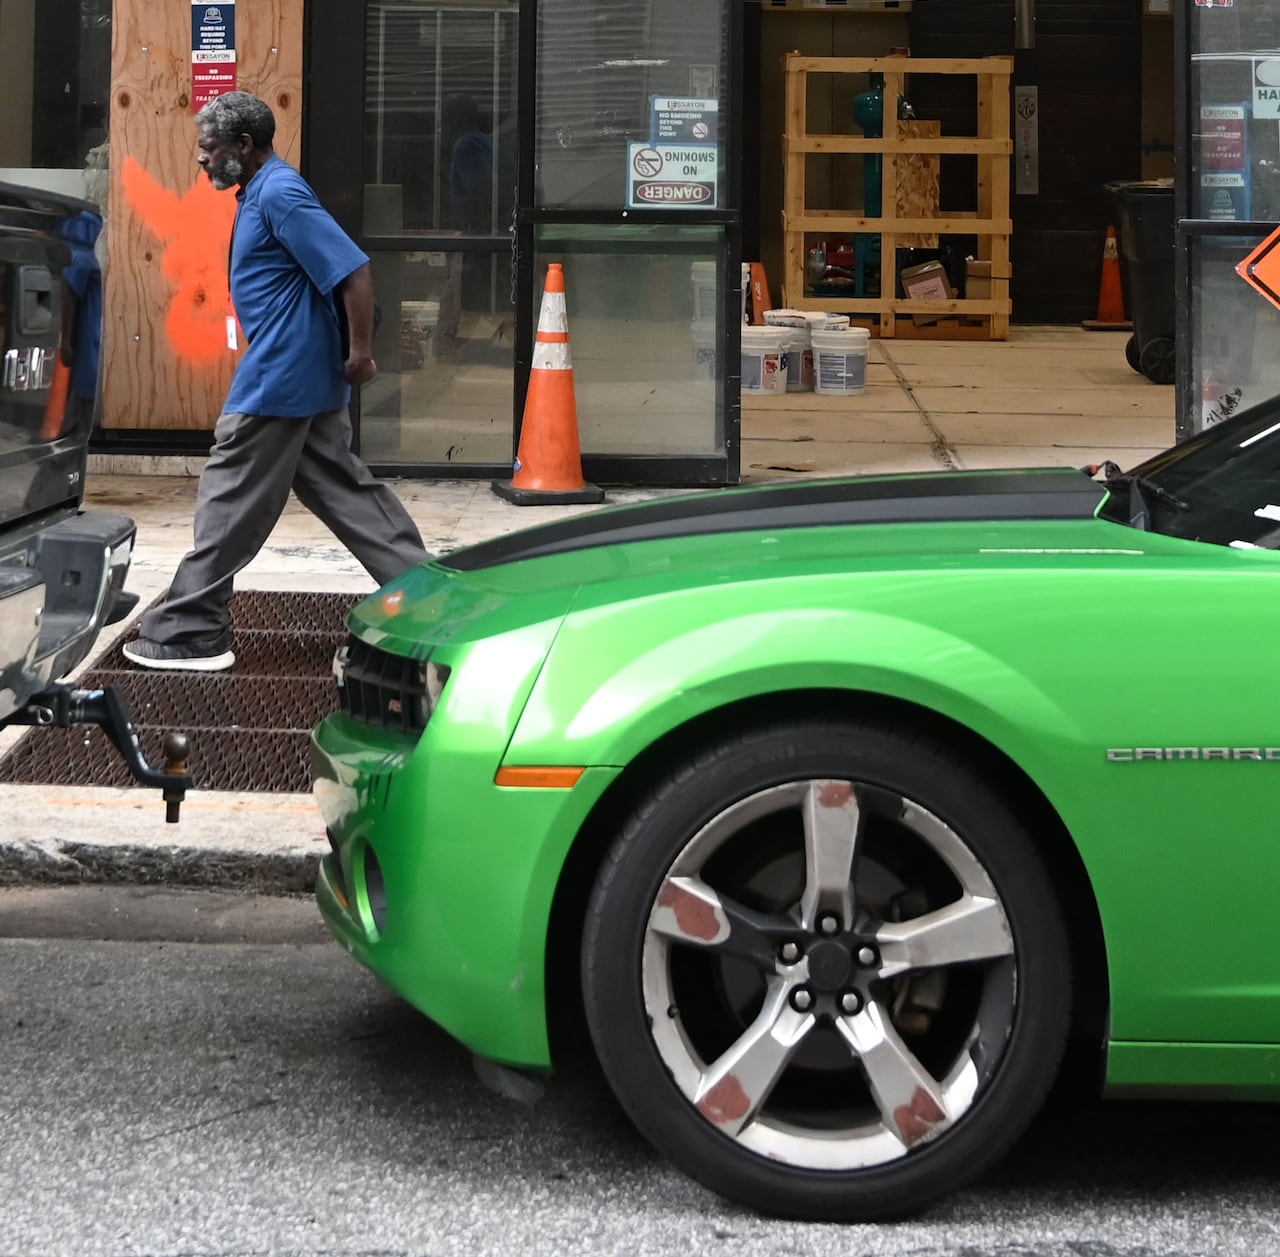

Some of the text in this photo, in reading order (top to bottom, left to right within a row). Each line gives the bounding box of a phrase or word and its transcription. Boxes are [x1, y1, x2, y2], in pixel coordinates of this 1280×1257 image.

[664, 151, 715, 162] SMOKING
[682, 165, 697, 175] NO
[644, 186, 702, 199] DANGER
